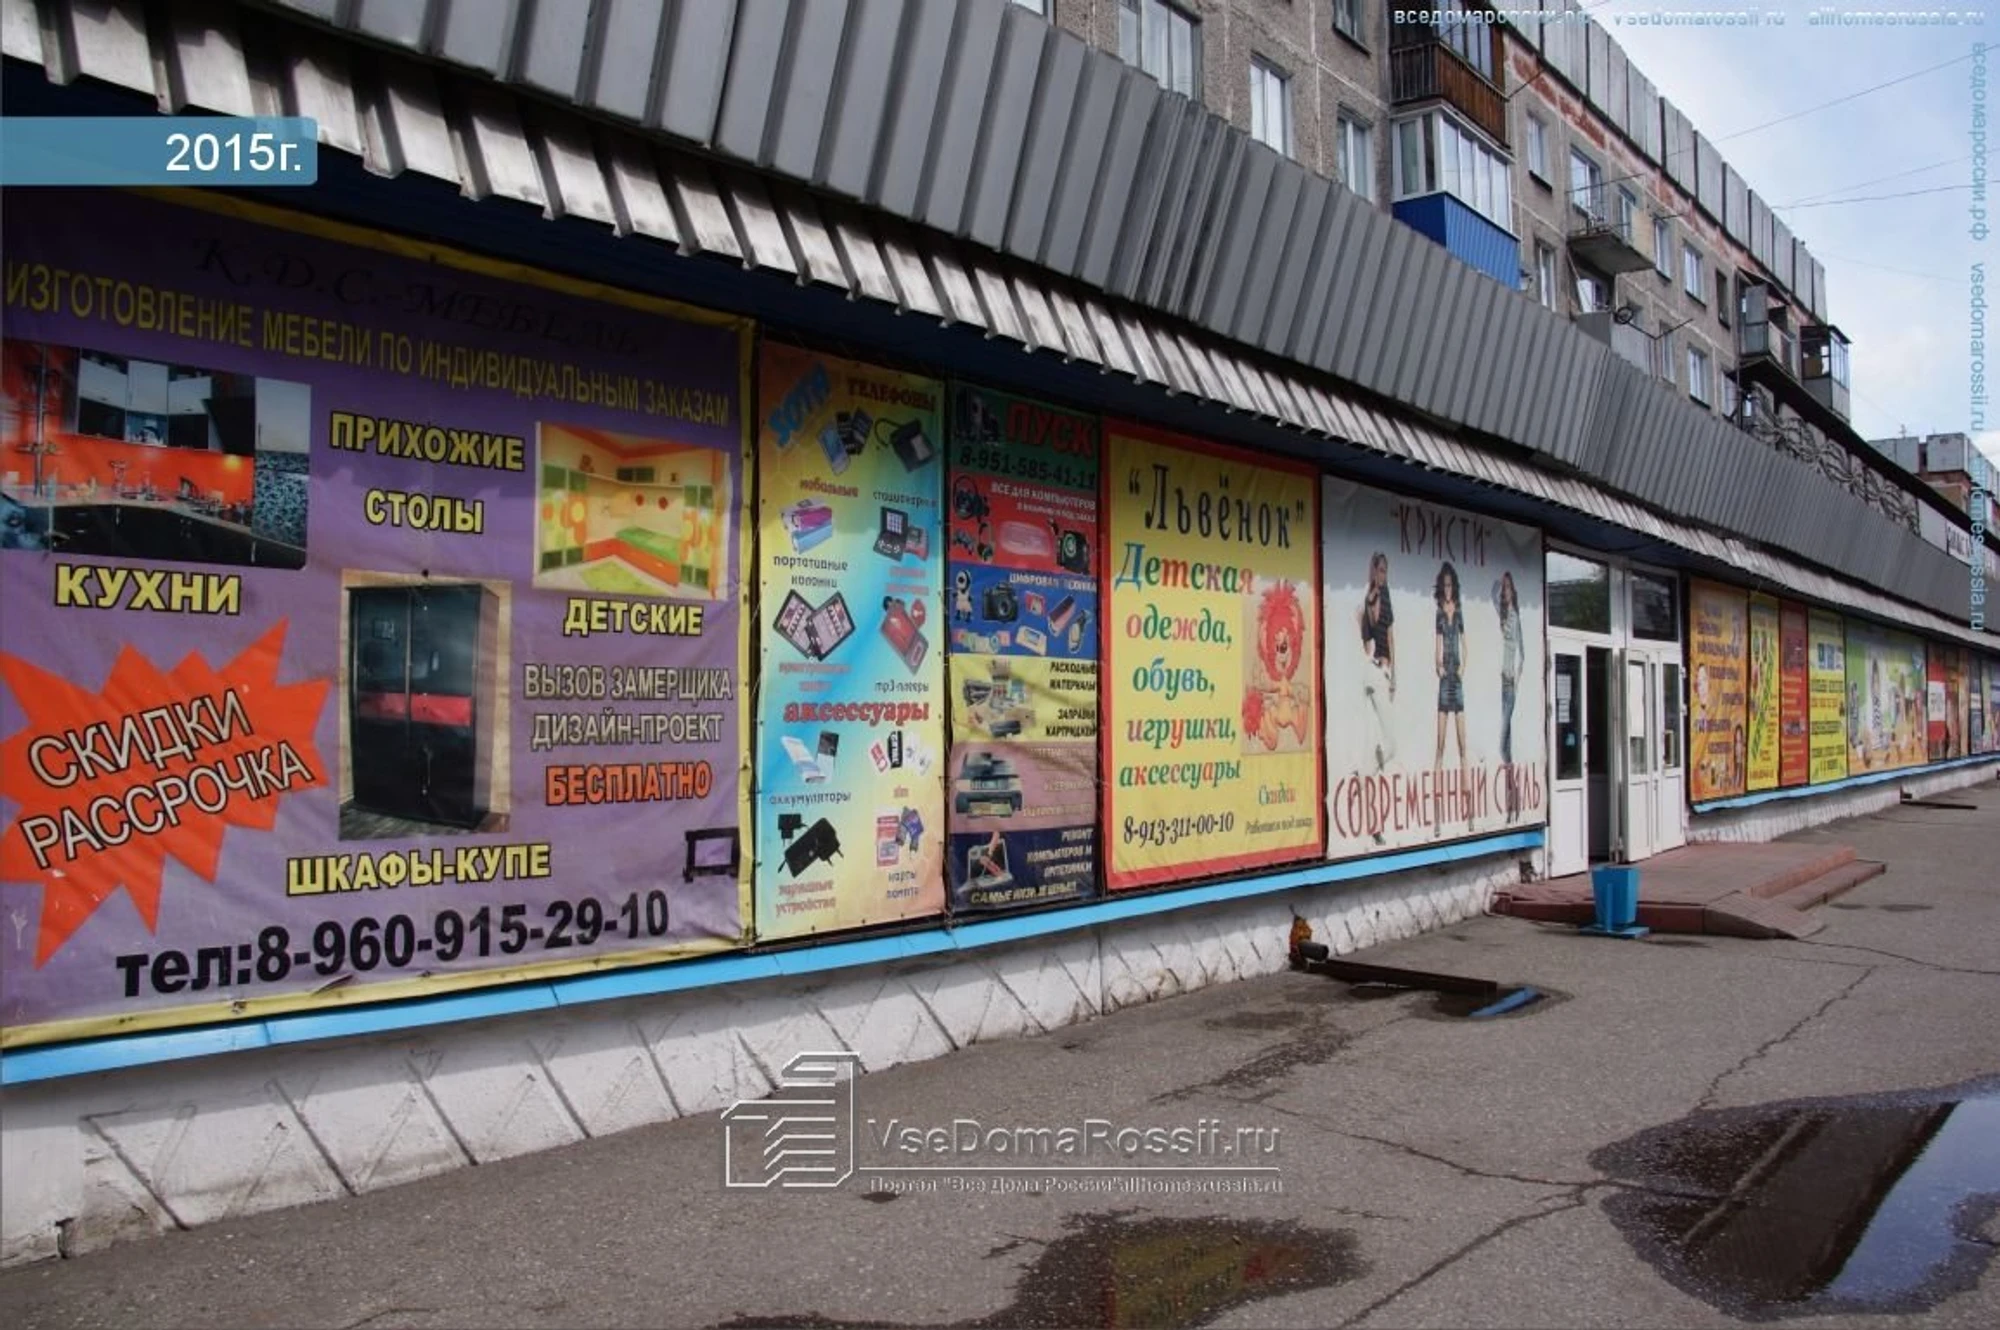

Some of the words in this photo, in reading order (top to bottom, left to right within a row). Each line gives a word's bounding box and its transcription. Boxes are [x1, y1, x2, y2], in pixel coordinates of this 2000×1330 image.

[5, 260, 253, 348] ИЗГОТОВЛЕНИЕ
[262, 308, 372, 367] МЕБЕЛИ
[380, 330, 413, 374] ПО
[418, 342, 640, 412] ИНДИВИДУАЛЬНЫМ
[644, 383, 730, 429] ЗАКАЗАМ
[329, 411, 526, 472] ПРИХОЖИЕ
[1006, 401, 1095, 460] ПУСК
[364, 488, 485, 534] СТОЛЫ
[773, 555, 848, 570] портативные
[1114, 541, 1255, 594] Детская
[55, 563, 241, 615] КУХНИ
[563, 597, 703, 637] ДЕТСКИЕ
[1126, 603, 1233, 650] одежда,
[523, 663, 606, 700] ВЫЗОВ
[610, 667, 734, 707] ЗАМЕРЩИКА
[1133, 656, 1215, 700] обувь,
[531, 707, 724, 752] ДИЗАЙН-ПРОЕКТ
[783, 701, 929, 727] аксессуары
[1127, 717, 1236, 749] игрушки,
[28, 687, 253, 788] СКИДКИ
[546, 760, 712, 806] БЕСПЛАТНО
[1120, 760, 1241, 789] аксессуары
[20, 740, 315, 869] РАССРОЧКА
[769, 791, 852, 807] аккумуляторы
[1334, 757, 1488, 839] СОВРЕМЕННЫЙ
[1494, 761, 1542, 820] СТИЛЬ
[1123, 811, 1235, 848] 8-913-311-00-10
[286, 843, 552, 897] ШКАФЫ-КУПЕ
